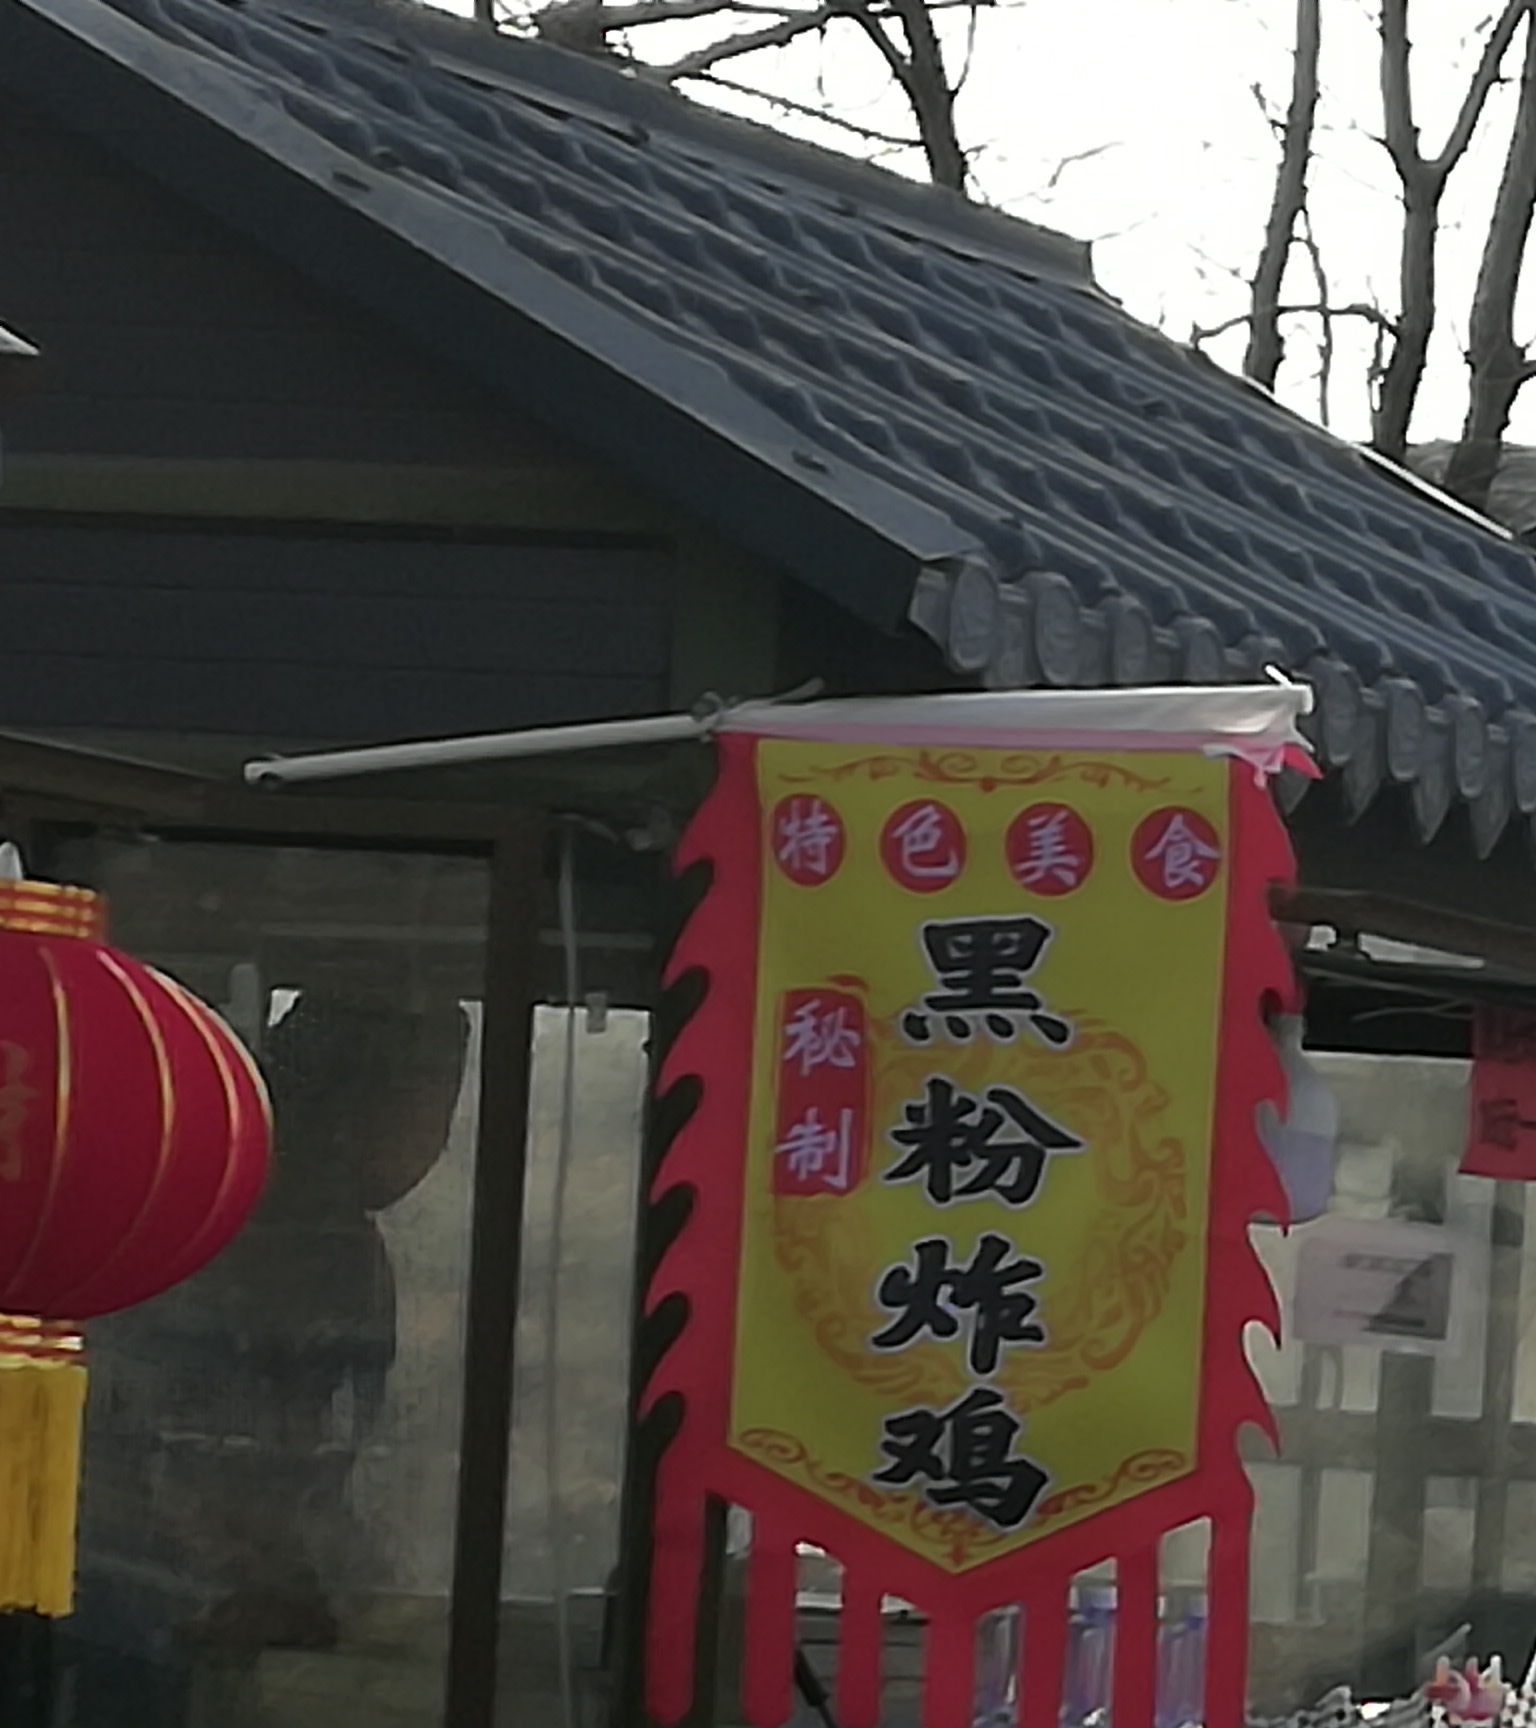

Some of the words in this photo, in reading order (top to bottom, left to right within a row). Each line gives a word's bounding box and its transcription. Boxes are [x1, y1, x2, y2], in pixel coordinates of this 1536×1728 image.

[774, 804, 1222, 890] 特色美食
[774, 1002, 862, 1190] 秘制
[870, 915, 1084, 1531] 黑粉炸鸡
